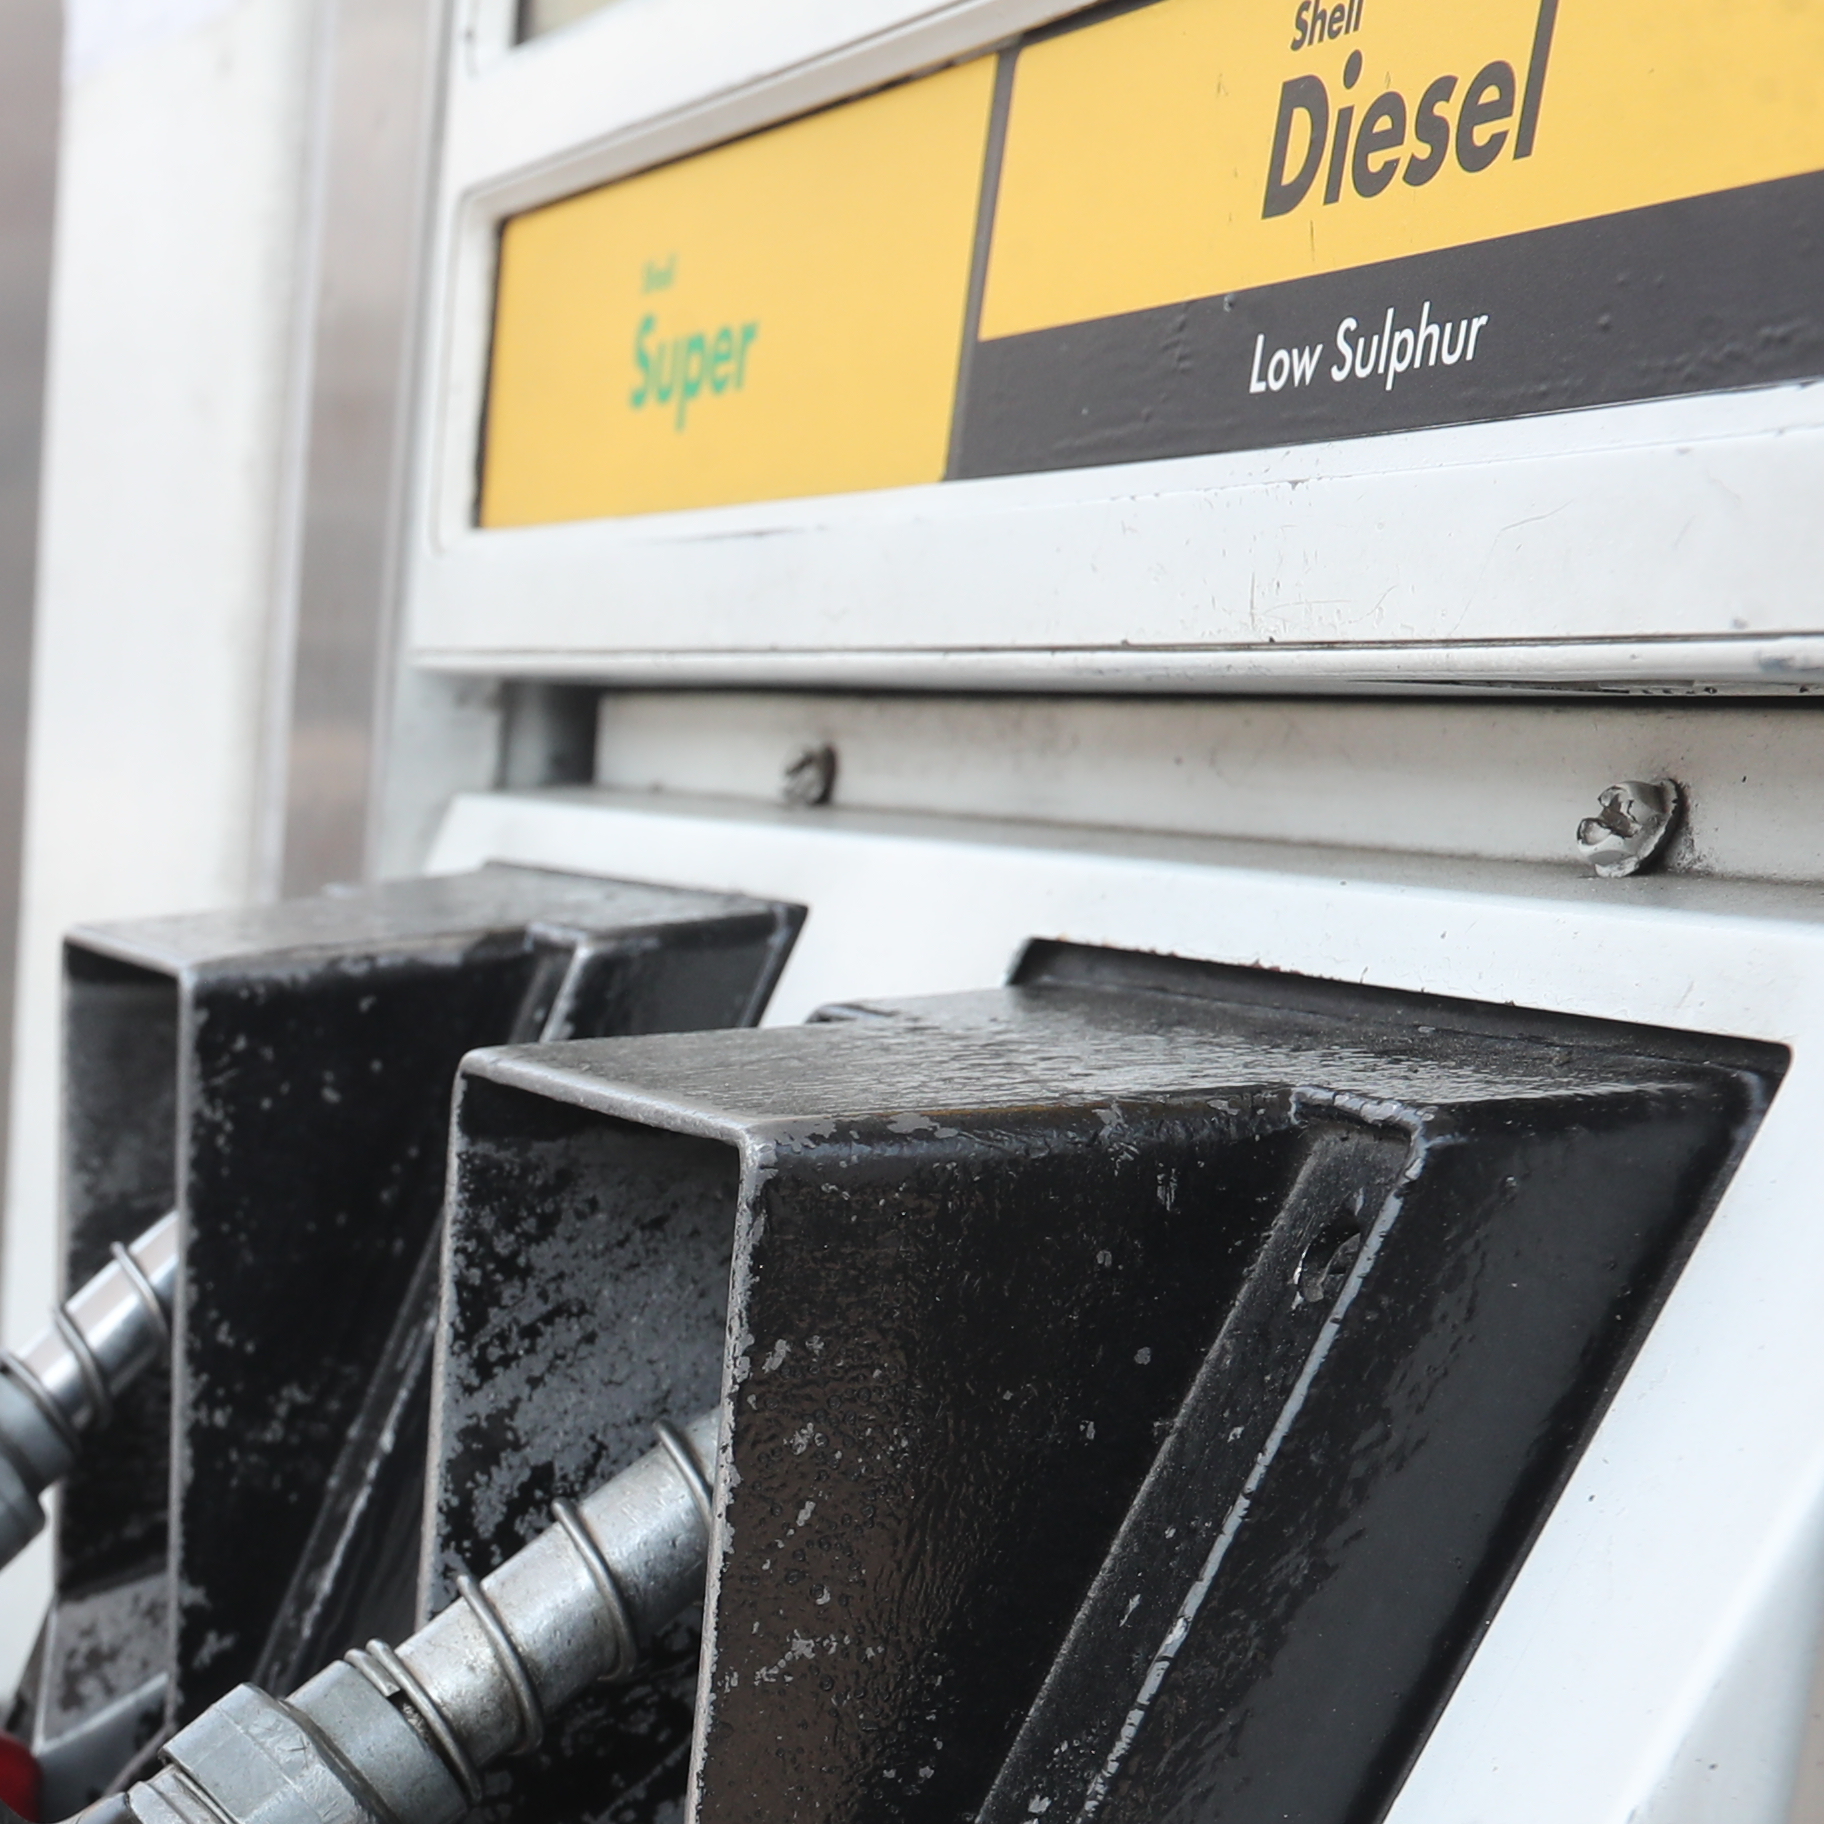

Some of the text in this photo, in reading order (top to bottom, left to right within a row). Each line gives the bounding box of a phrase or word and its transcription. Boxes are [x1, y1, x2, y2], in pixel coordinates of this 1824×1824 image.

[1290, 0, 1365, 51] Shell
[1261, 0, 1559, 220] Diesel
[629, 311, 759, 433] Super
[1249, 300, 1490, 394] Low Sulphur
